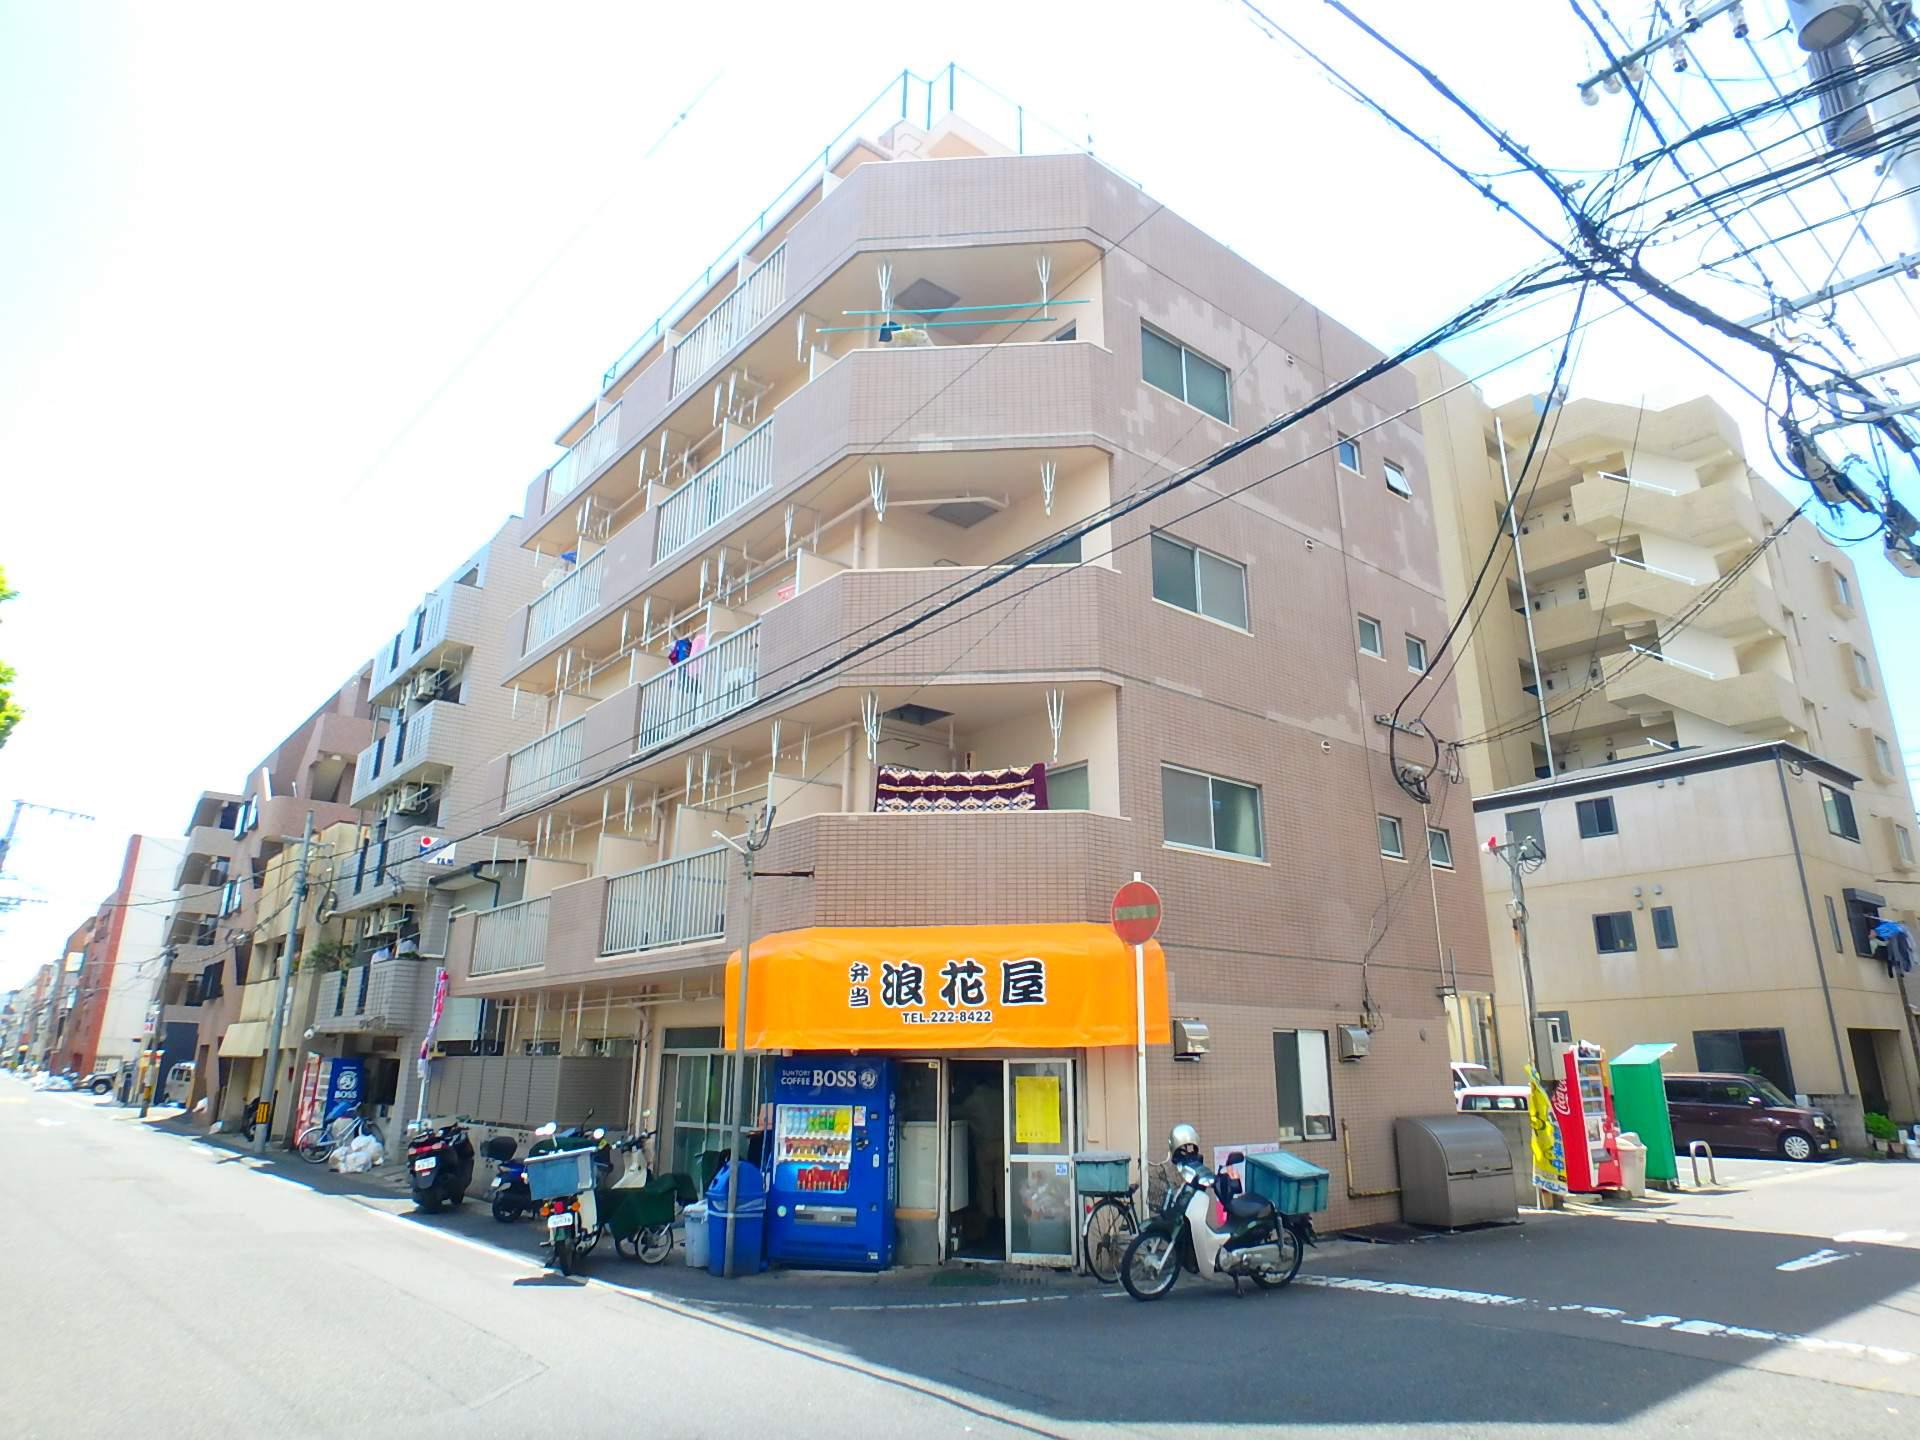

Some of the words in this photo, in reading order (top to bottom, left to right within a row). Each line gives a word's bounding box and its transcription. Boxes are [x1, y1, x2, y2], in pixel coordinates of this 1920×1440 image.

[850, 962, 869, 1007] 弁当
[882, 960, 1045, 1006] 浪花屋
[782, 1069, 811, 1077] SUNTORY
[812, 1069, 857, 1087] BOSS
[780, 1076, 811, 1086] COFFEE
[334, 1090, 358, 1099] BOSS
